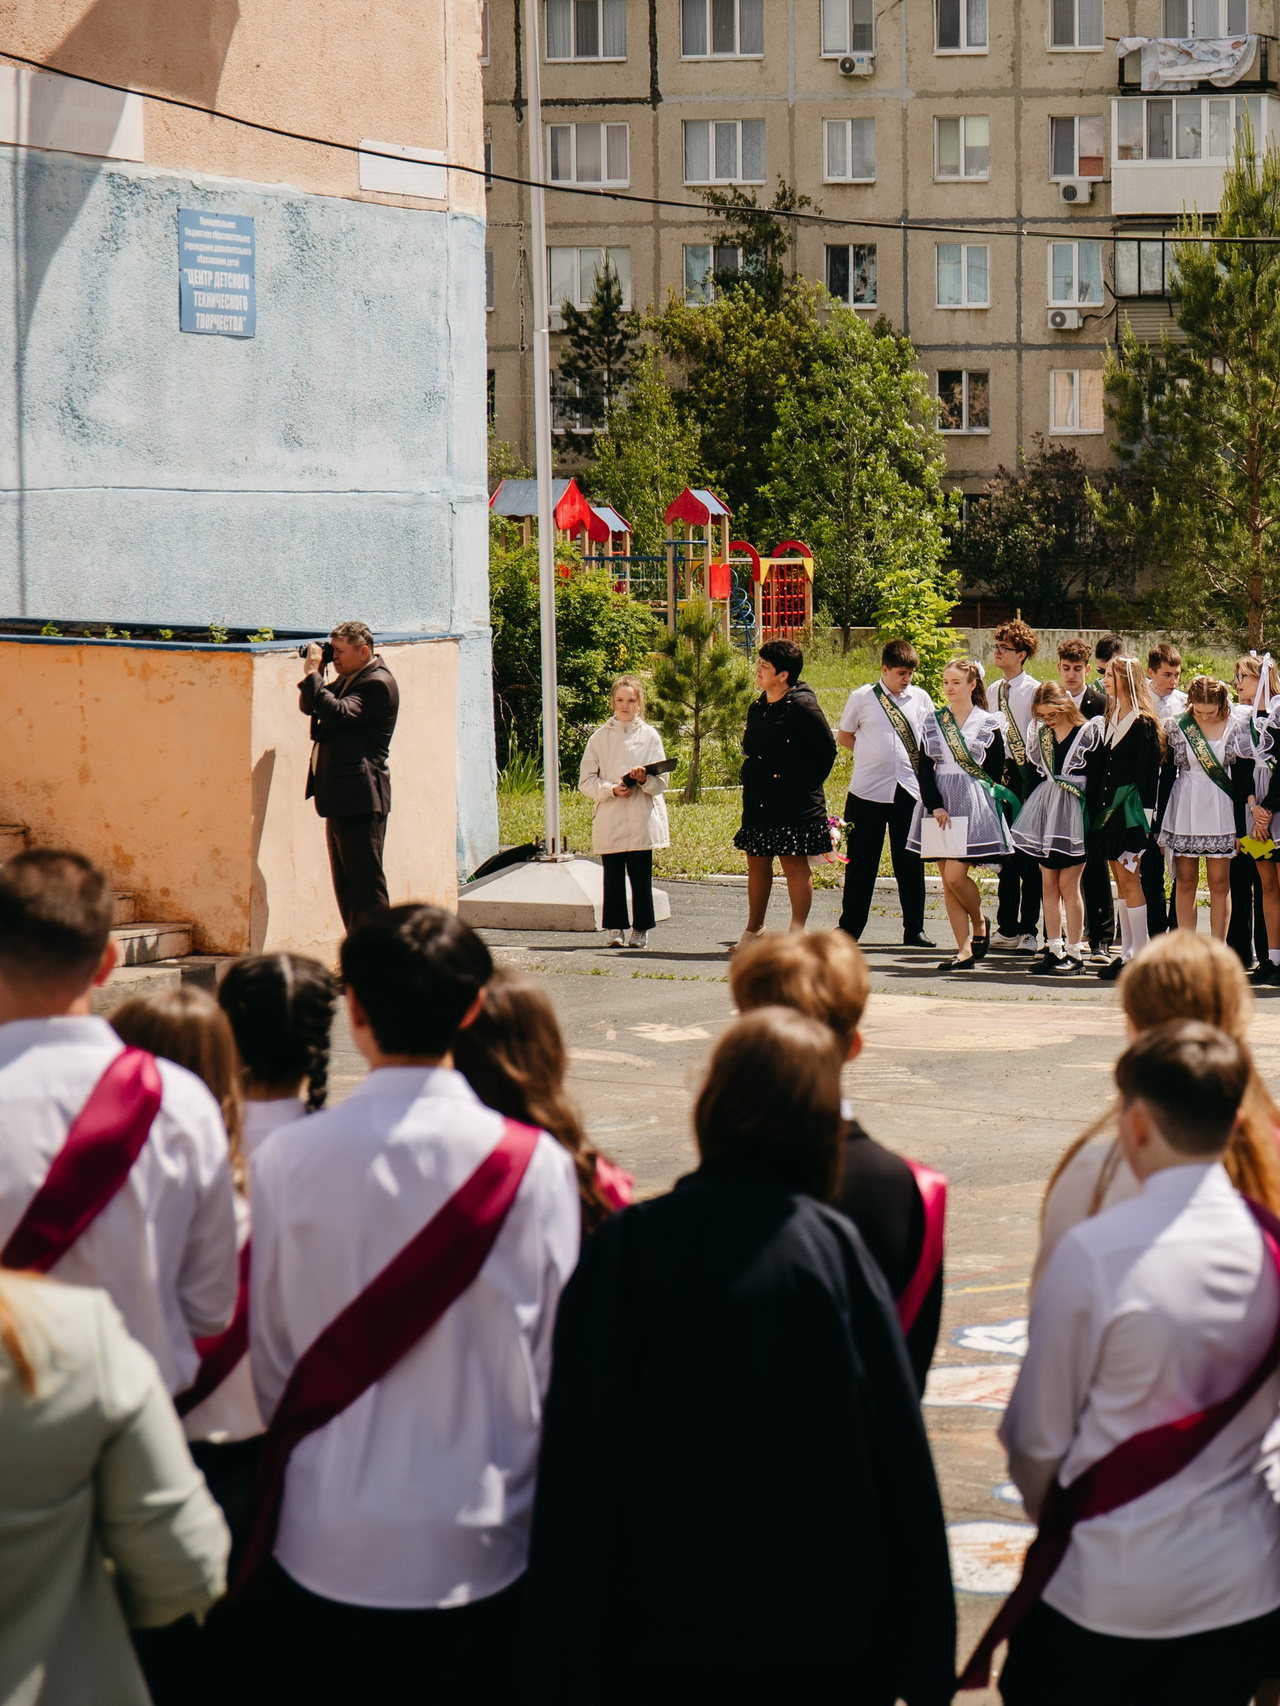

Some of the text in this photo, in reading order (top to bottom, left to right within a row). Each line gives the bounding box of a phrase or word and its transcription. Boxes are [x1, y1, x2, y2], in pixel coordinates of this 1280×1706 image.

[183, 268, 250, 290] "ЦЕНТР ДЕТСКОГО
[193, 290, 249, 311] ТЕХНИЧЕСКОГО
[195, 312, 247, 332] ТВОРЧЕСТВА"
